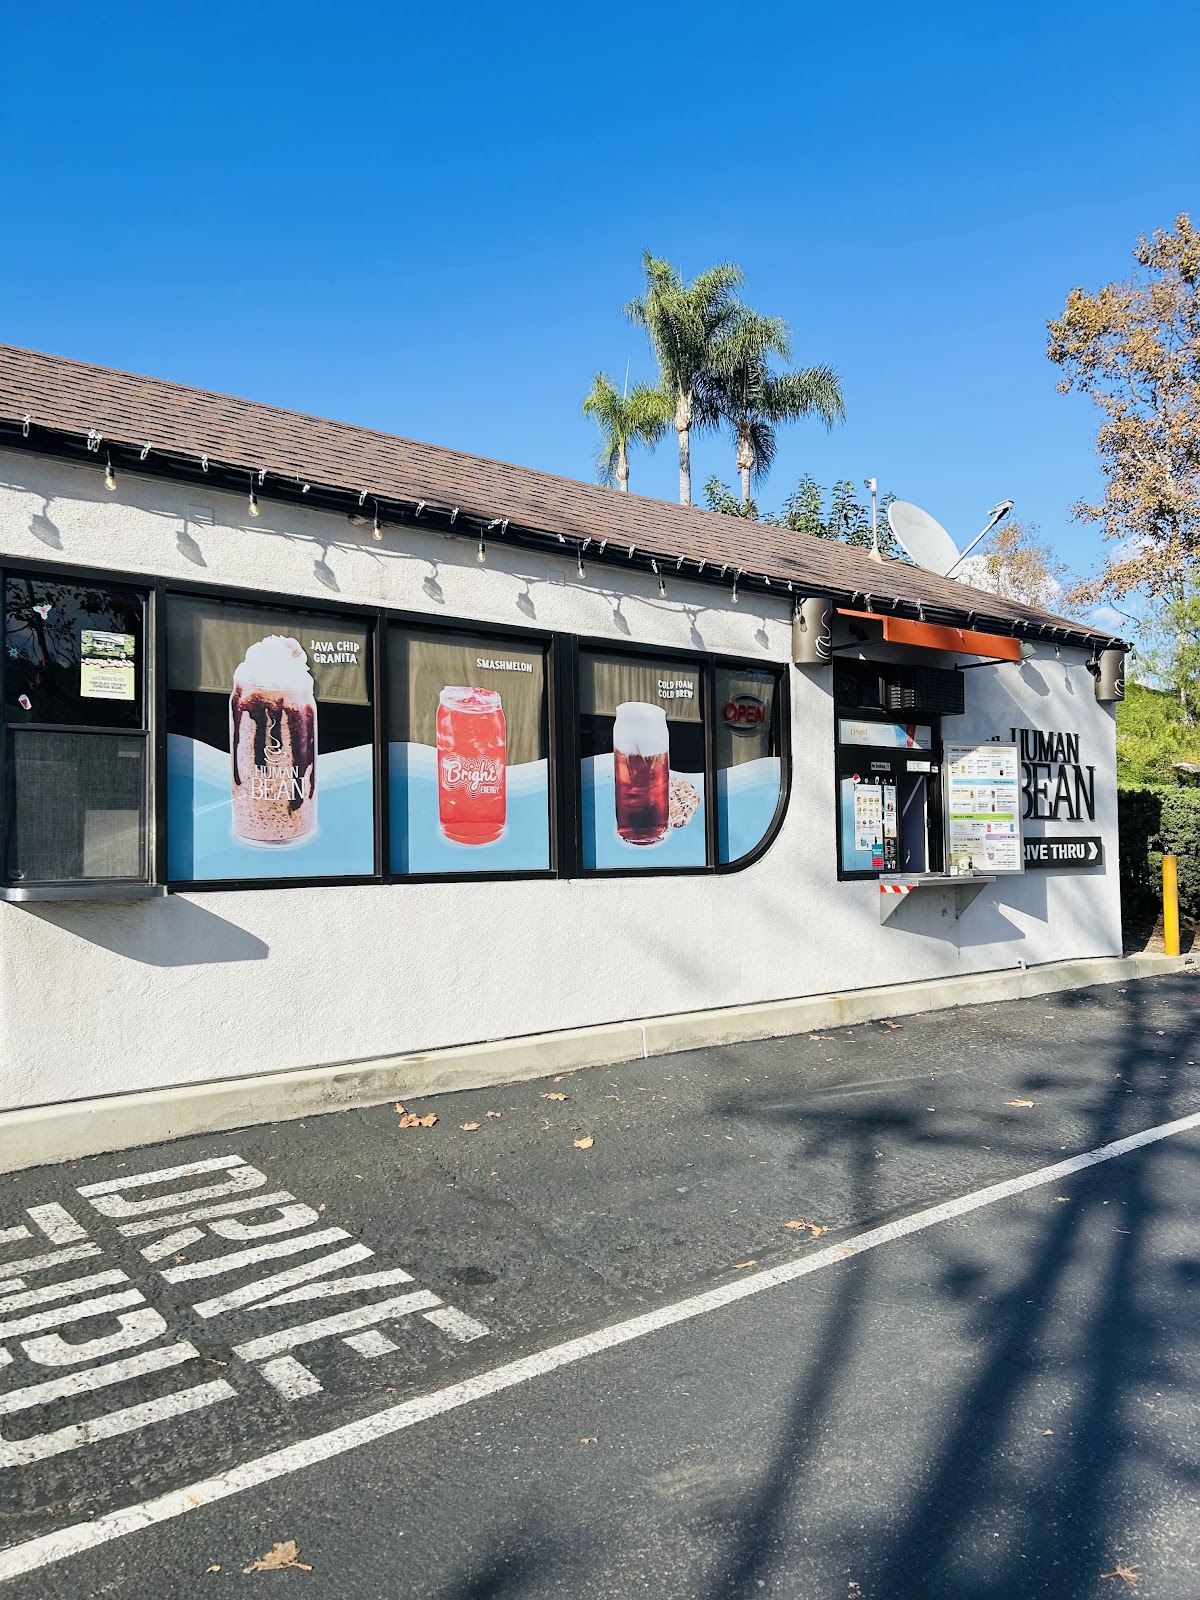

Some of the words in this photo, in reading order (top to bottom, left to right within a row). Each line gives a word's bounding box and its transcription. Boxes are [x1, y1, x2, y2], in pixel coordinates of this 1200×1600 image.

[310, 640, 334, 652] JAVA
[337, 641, 360, 653] CHIP
[313, 653, 357, 664] GRANITA
[476, 658, 532, 673] SMASHMELON
[658, 680, 674, 690] COLD
[676, 680, 693, 690] FOAM
[658, 690, 674, 699] COLD
[676, 690, 693, 699] BREW
[723, 702, 765, 723] OPEN
[255, 765, 299, 778] HUMAN
[443, 760, 497, 790] Bright
[251, 776, 305, 801] BEAN
[480, 786, 499, 794] ENERGY
[1024, 844, 1048, 860] IVE
[1050, 844, 1086, 860] THRU
[76, 1154, 490, 1402] DRIVE
